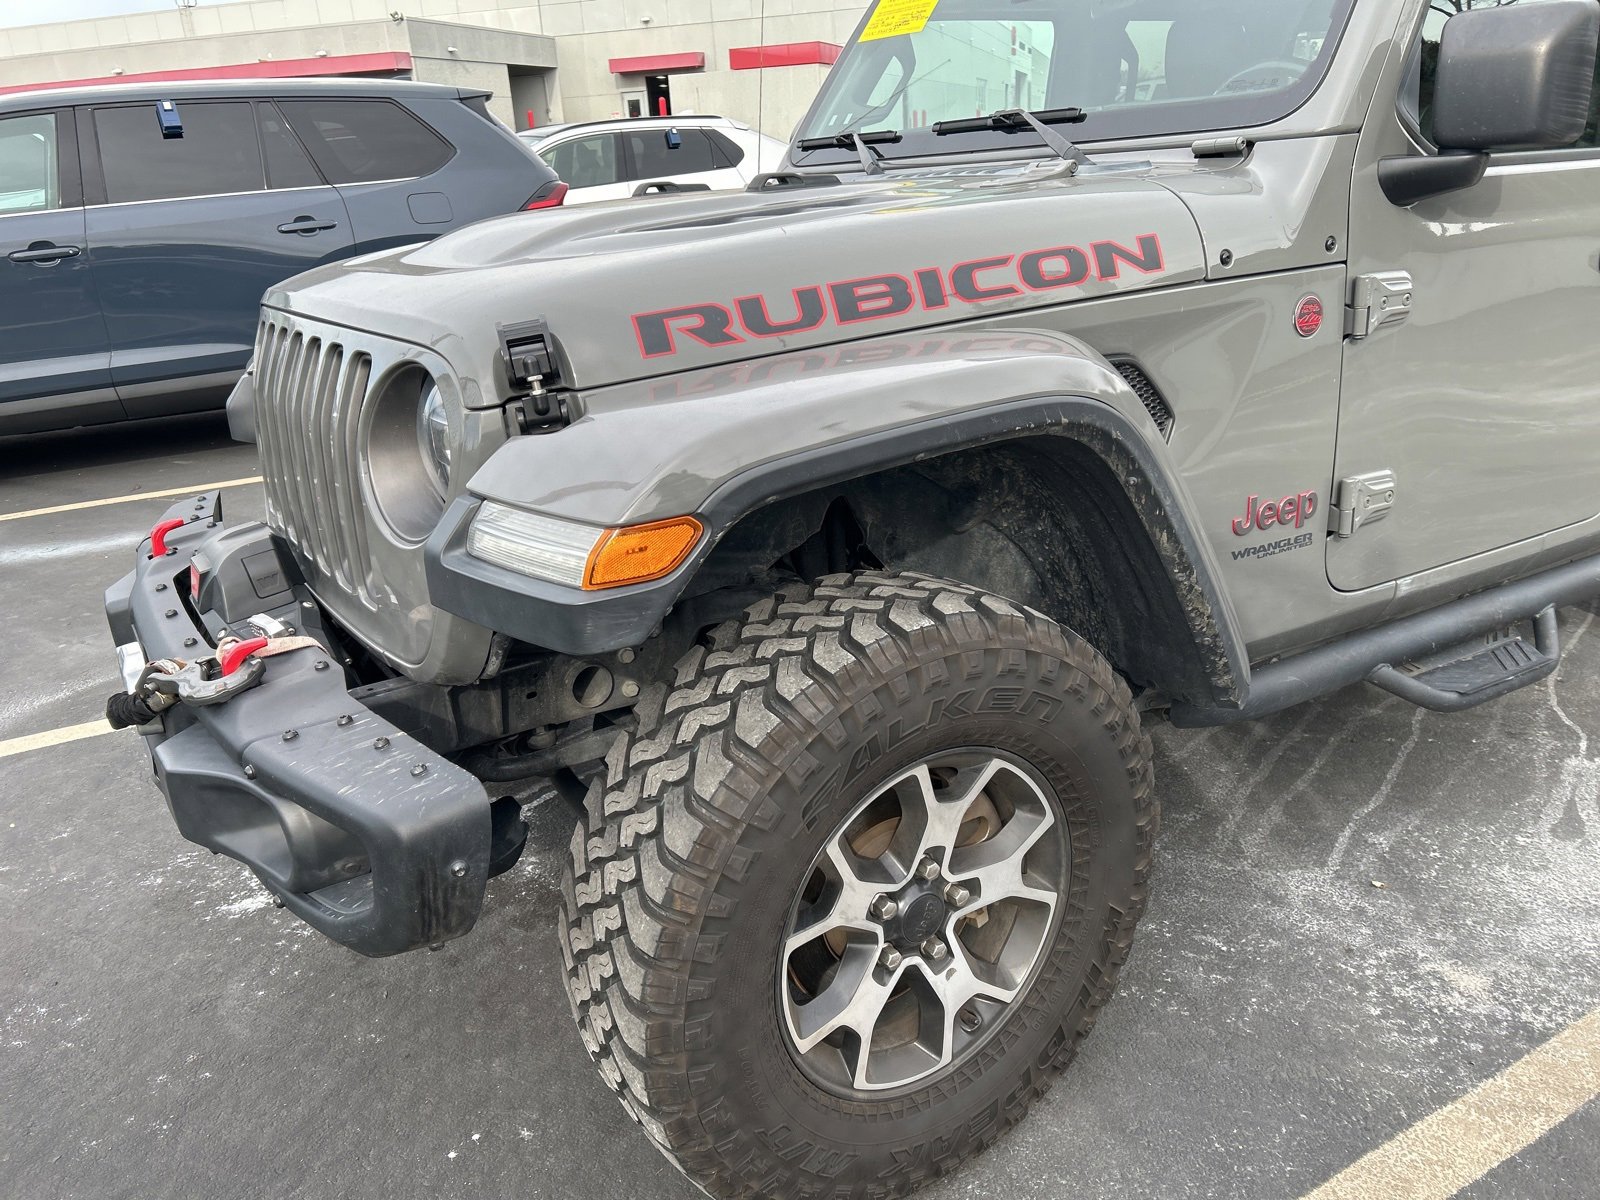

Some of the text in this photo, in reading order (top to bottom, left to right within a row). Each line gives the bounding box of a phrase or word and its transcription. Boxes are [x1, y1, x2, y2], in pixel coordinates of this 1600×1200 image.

[629, 233, 1166, 359] RUBICON
[1232, 490, 1318, 536] Jeep
[1231, 533, 1312, 560] WRANGLER
[1257, 541, 1312, 559] UNLIMITED
[793, 686, 1064, 835] FALKEN
